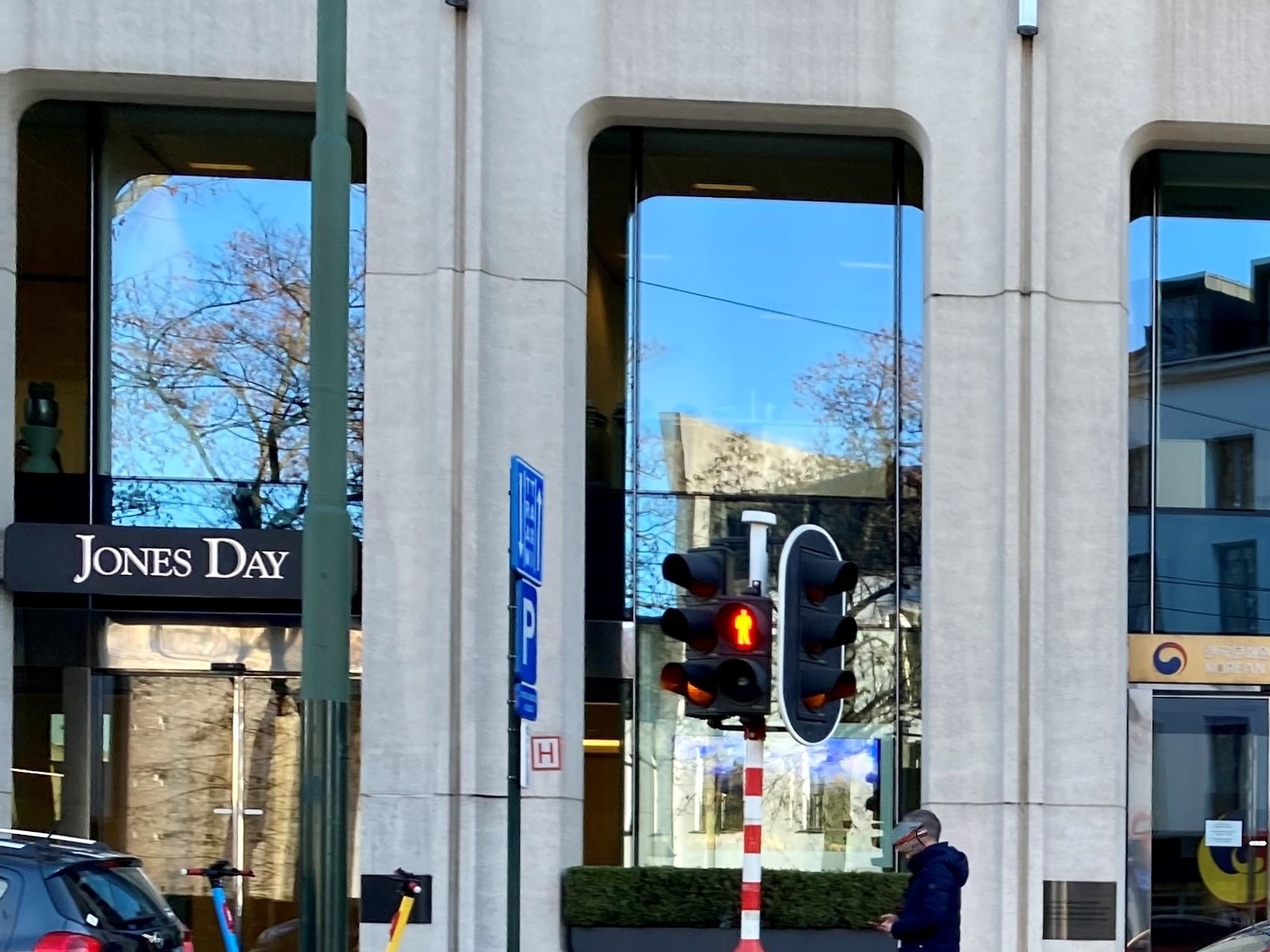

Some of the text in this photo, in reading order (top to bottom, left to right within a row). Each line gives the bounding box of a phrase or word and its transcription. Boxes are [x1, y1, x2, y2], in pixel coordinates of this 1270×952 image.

[73, 534, 290, 583] JONES DAY
[522, 597, 536, 665] P
[1205, 662, 1265, 675] KOREAN
[539, 742, 554, 764] H
